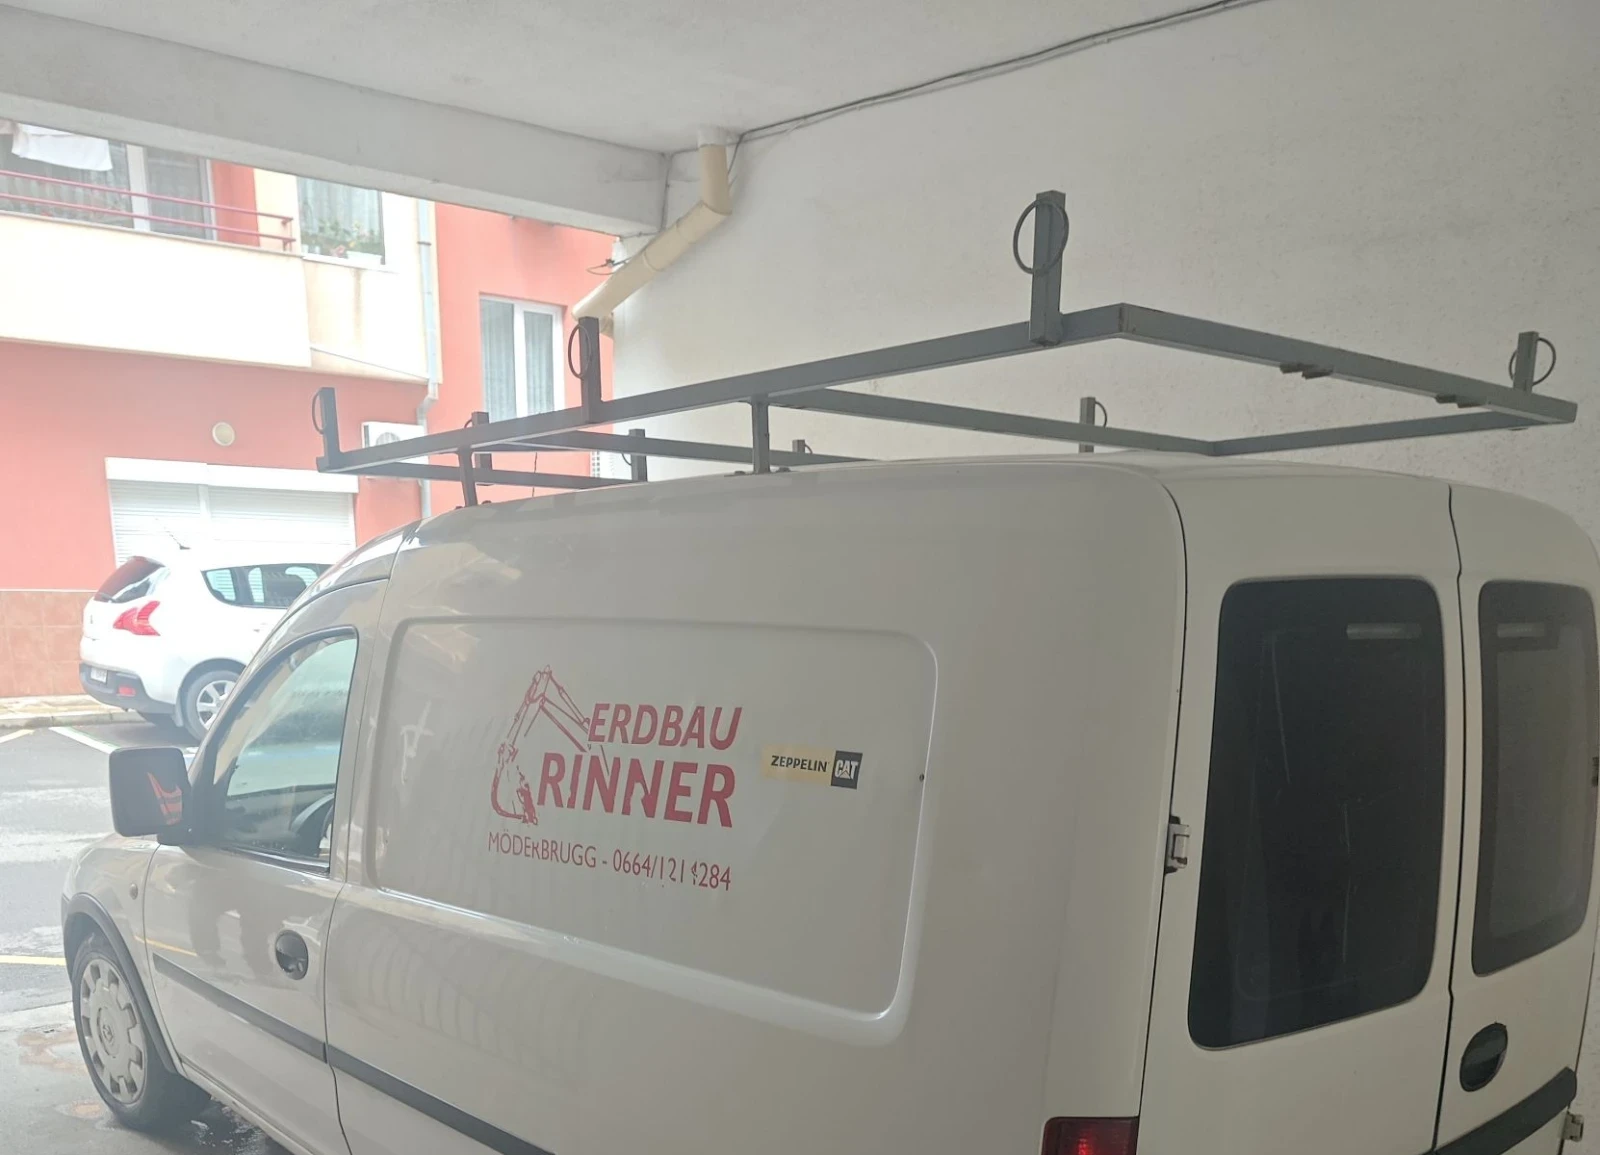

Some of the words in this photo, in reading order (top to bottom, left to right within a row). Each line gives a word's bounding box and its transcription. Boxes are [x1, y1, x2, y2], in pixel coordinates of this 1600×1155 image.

[588, 703, 742, 751] ERDBAU
[771, 755, 827, 773] ZEPPELIN
[834, 759, 859, 780] CAT
[537, 752, 736, 828] RINNER
